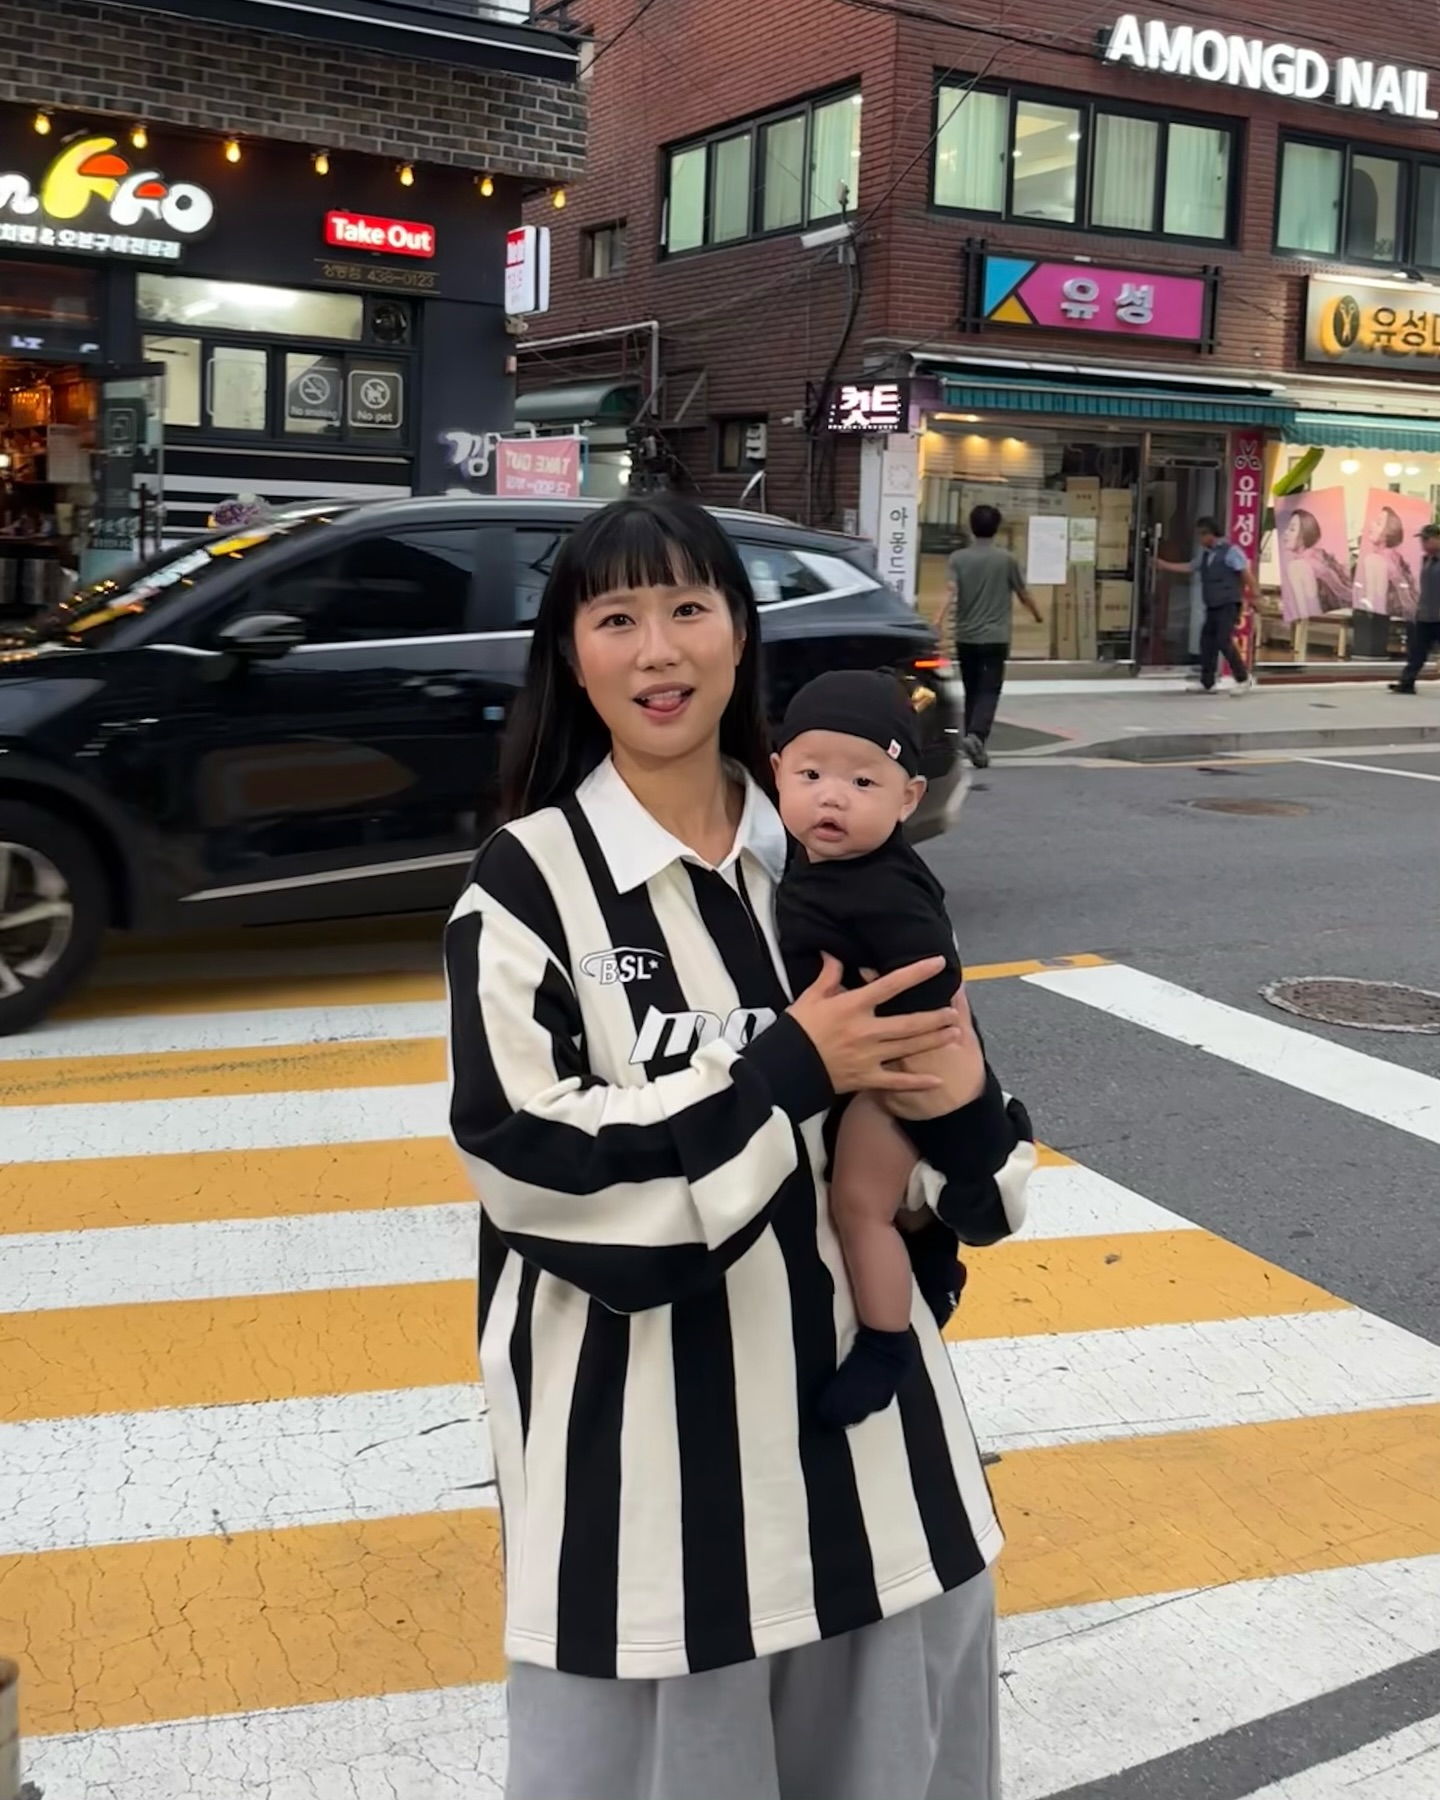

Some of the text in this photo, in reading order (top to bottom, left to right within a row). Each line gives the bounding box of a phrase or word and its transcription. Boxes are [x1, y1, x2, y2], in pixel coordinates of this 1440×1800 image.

[1105, 14, 1439, 119] AMONGD NAIL
[331, 217, 432, 252] Take Out
[1060, 277, 1154, 324] 유성
[357, 410, 394, 423] No pet
[1234, 476, 1258, 547] 유성
[600, 955, 651, 984] BSL
